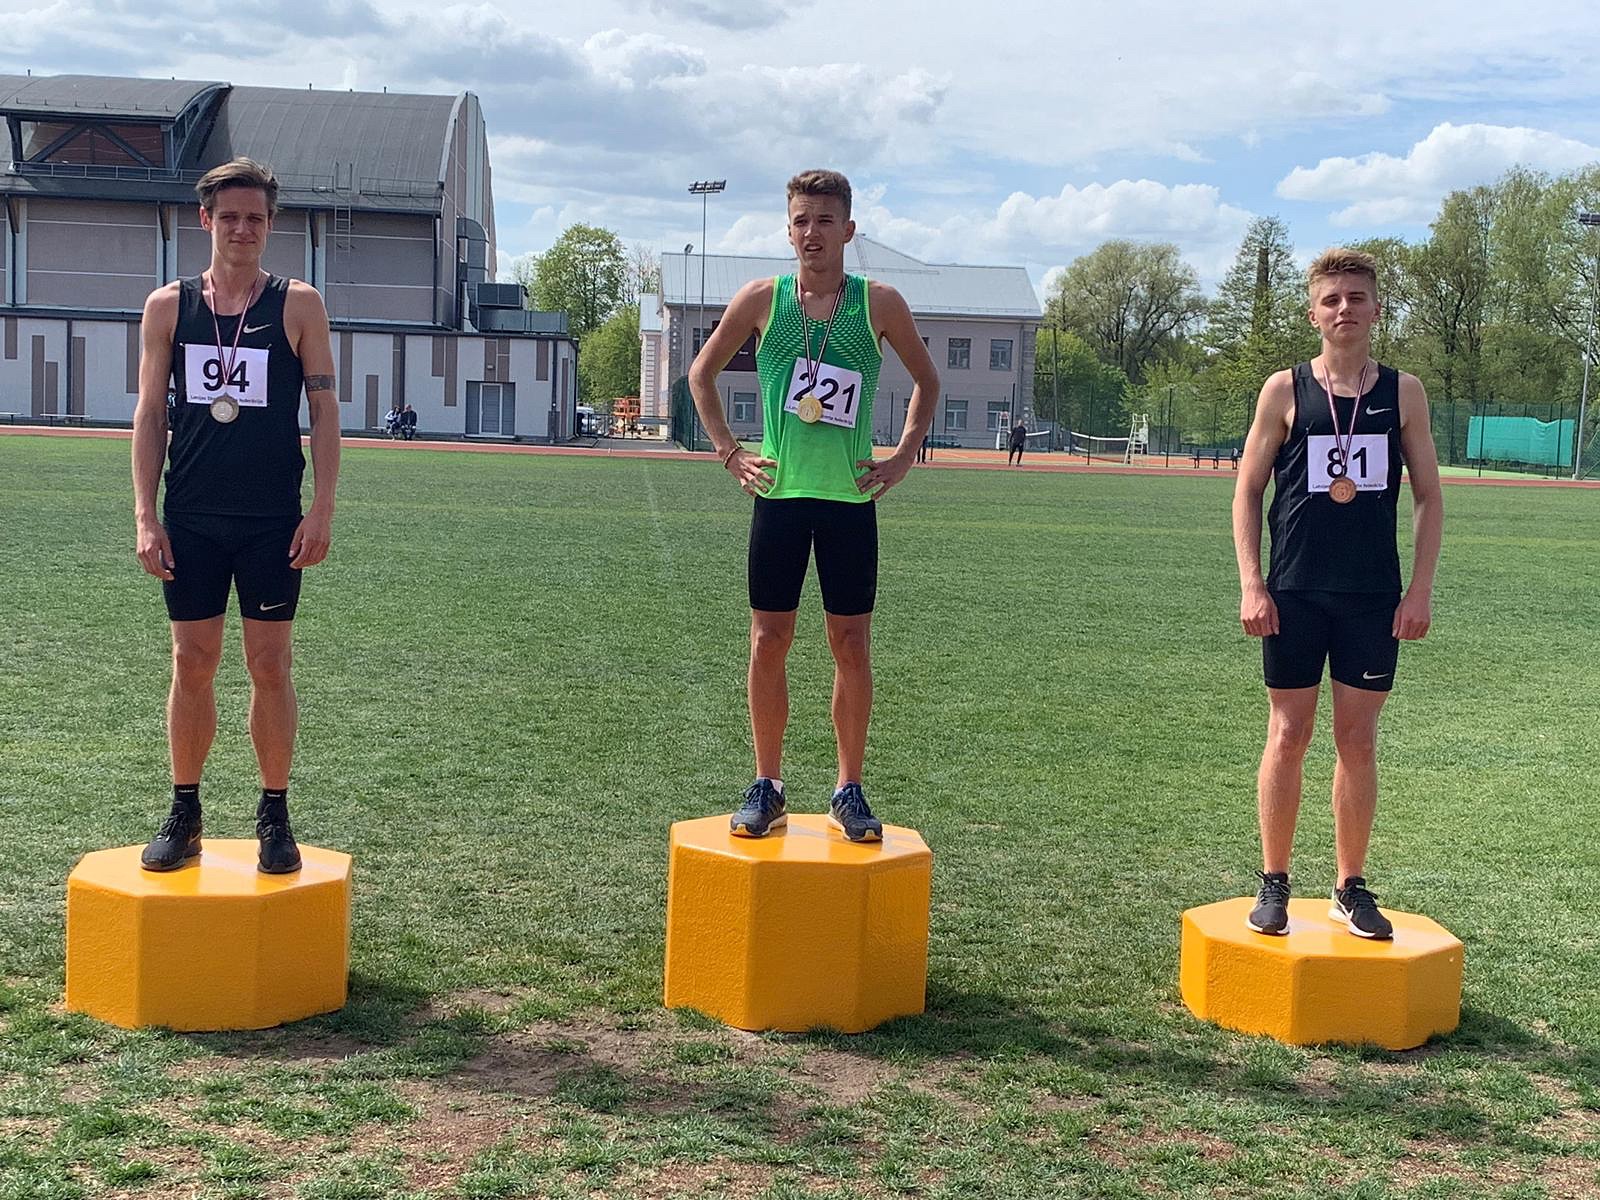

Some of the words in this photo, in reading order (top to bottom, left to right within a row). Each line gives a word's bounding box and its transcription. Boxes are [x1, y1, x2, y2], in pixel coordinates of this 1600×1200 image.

[203, 359, 249, 393] 94
[793, 372, 856, 415] 221
[1327, 447, 1367, 478] 81
